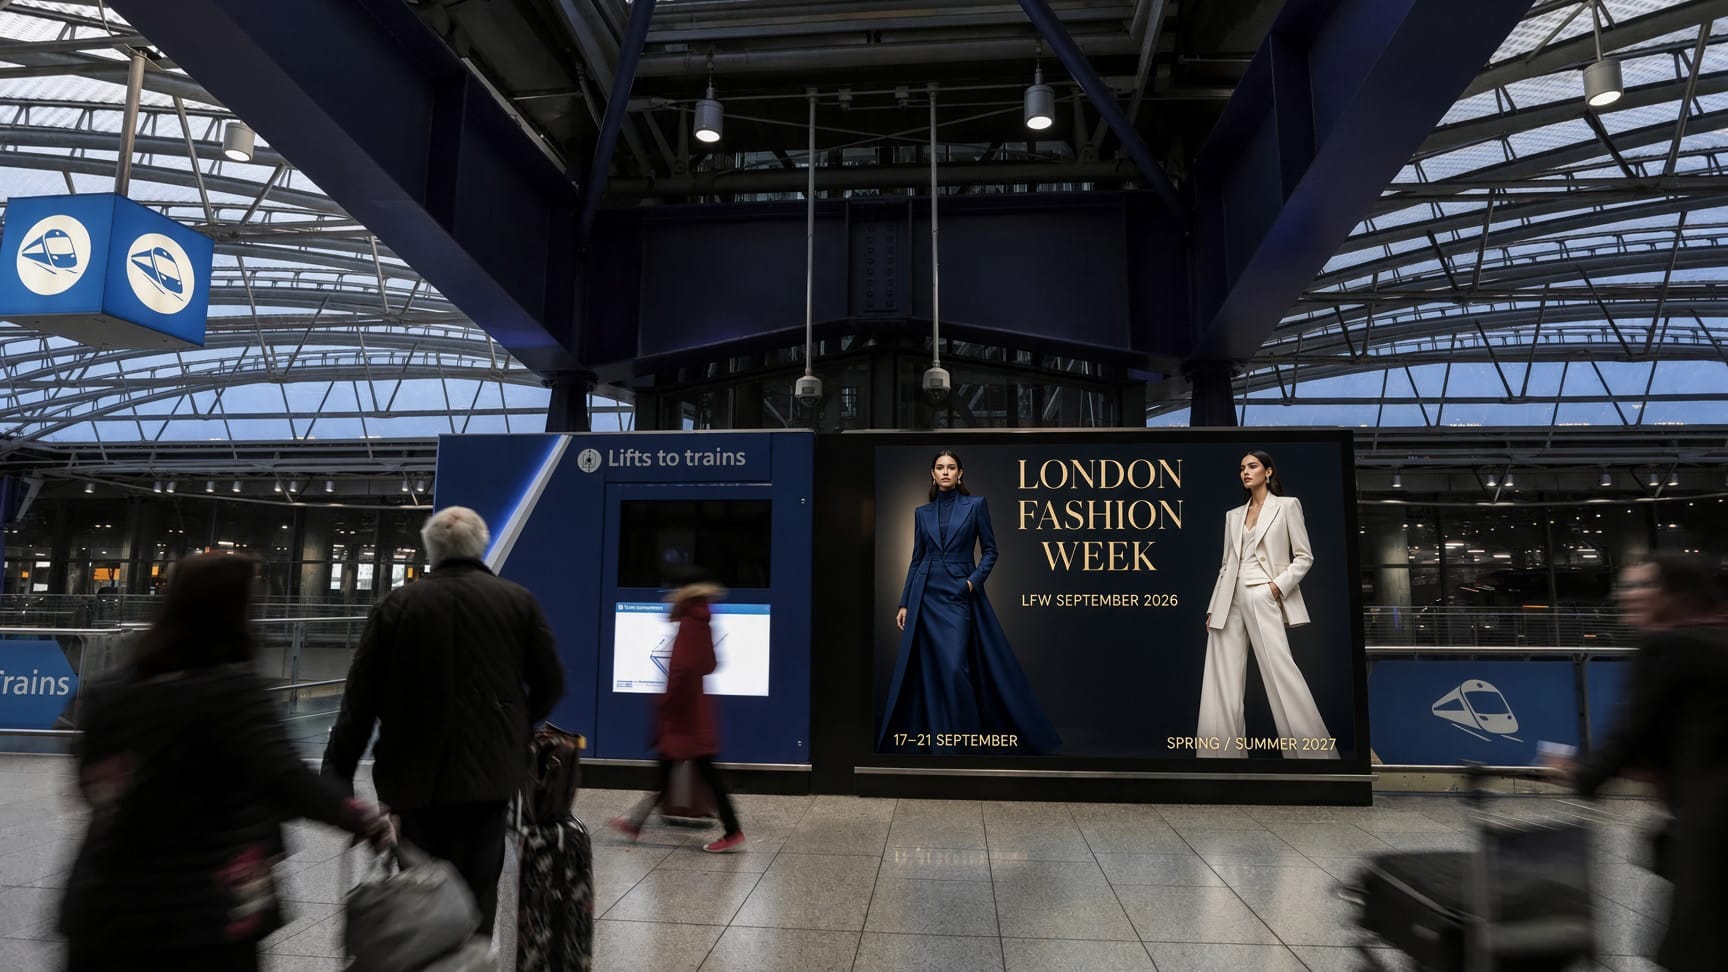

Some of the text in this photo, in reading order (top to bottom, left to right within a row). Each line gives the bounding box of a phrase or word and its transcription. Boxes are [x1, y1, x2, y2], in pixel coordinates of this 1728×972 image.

[608, 447, 747, 467] Lifts to trains
[1018, 458, 1183, 490] LONDON
[1018, 499, 1183, 531] FASHION
[1041, 541, 1158, 571] WEEK
[1021, 593, 1178, 607] LFW SEPTEMBER 2026
[0, 668, 70, 696] rains
[936, 733, 1019, 748] SEPTEMBER
[1166, 736, 1337, 752] SPRING / SUMMER 2027
